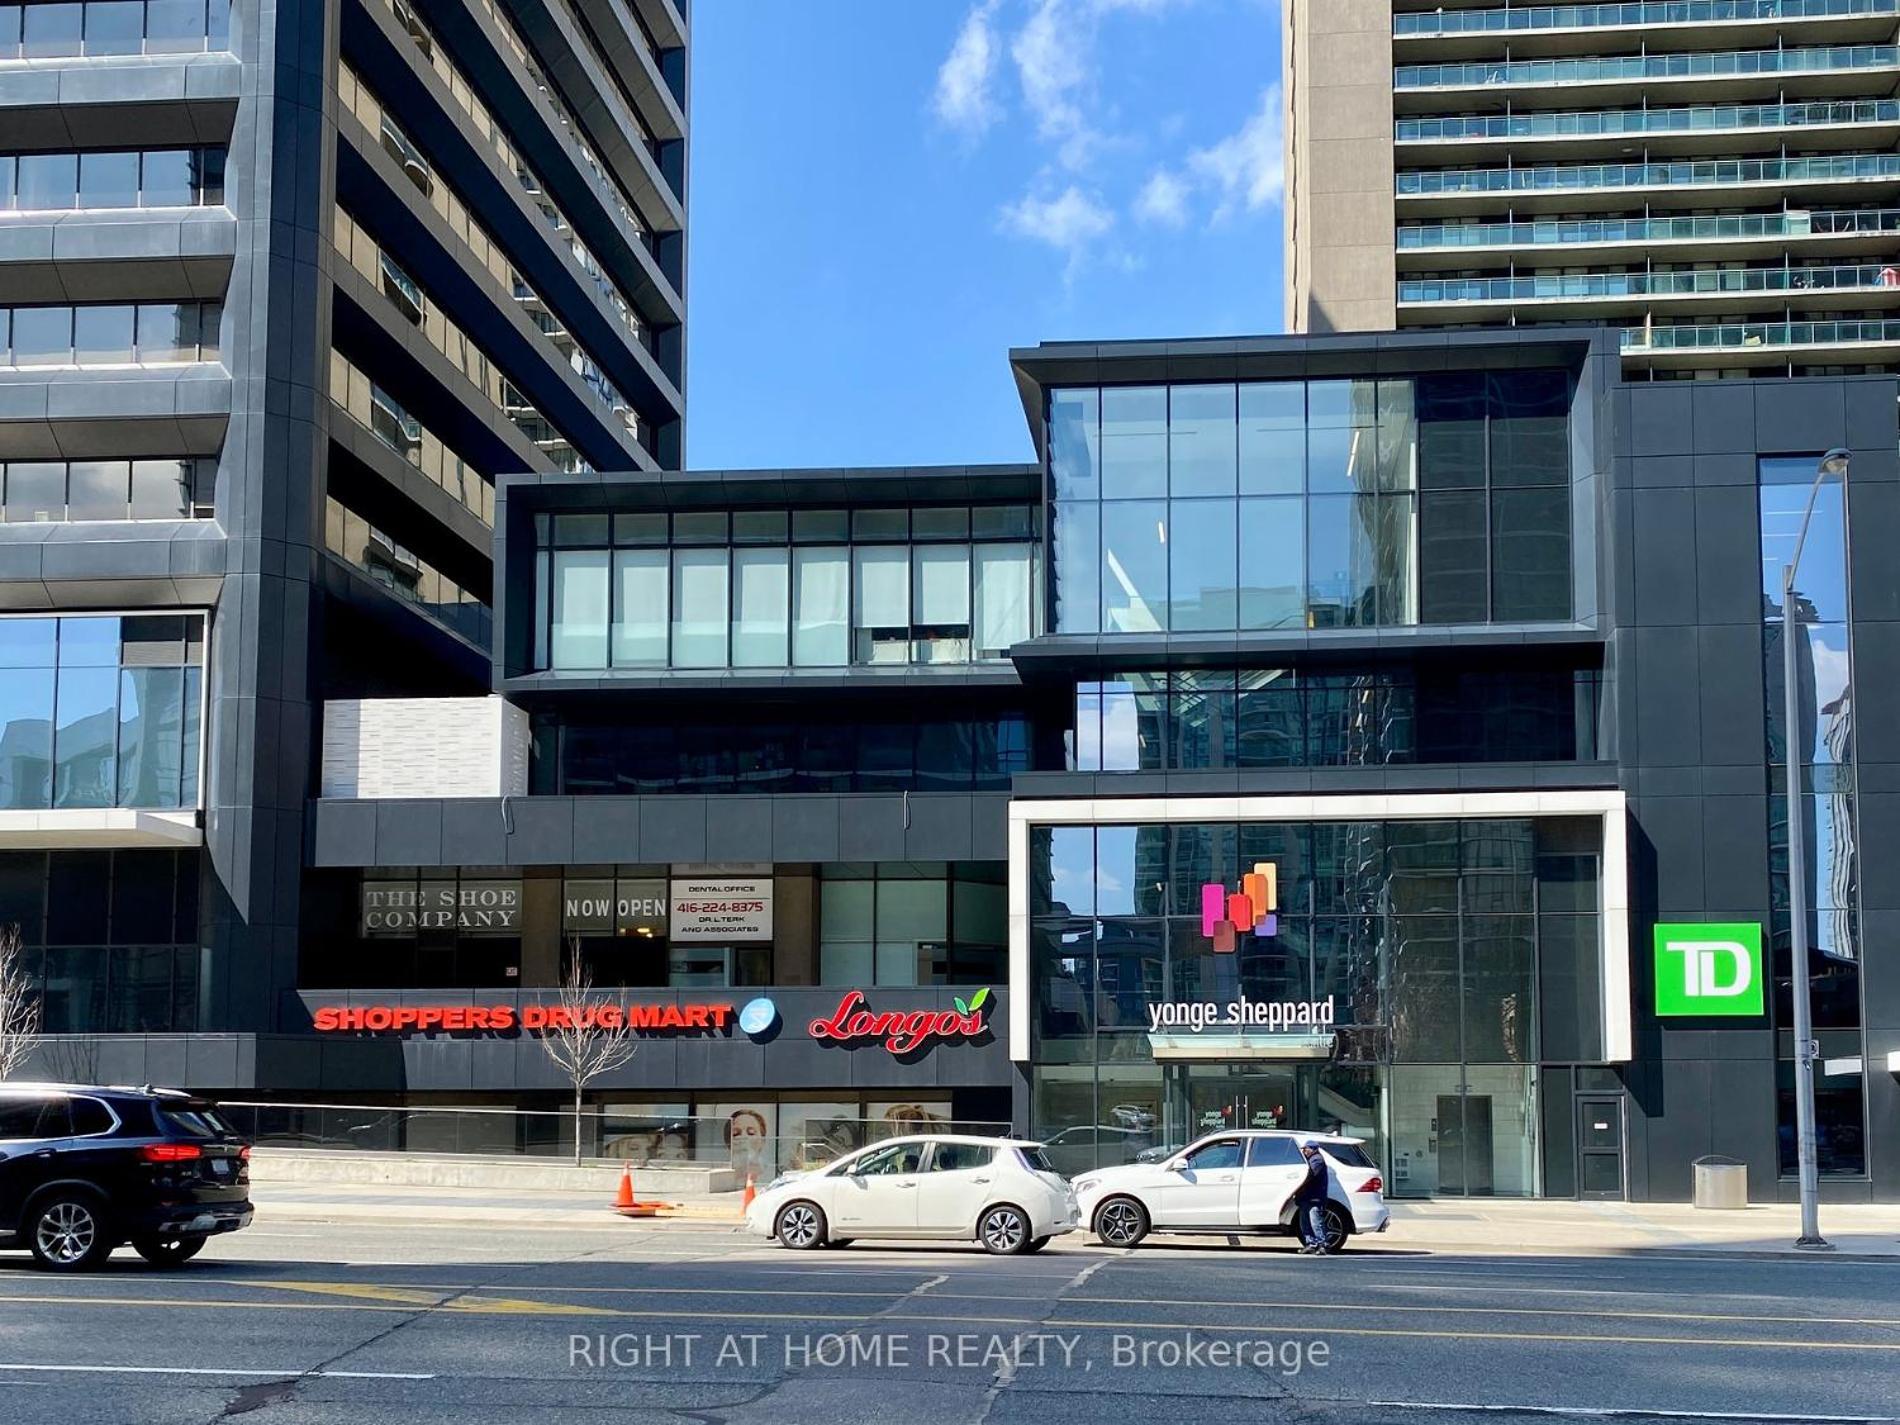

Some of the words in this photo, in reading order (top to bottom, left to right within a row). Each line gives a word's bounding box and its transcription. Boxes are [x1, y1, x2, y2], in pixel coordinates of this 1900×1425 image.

[366, 891, 426, 906] THE
[440, 889, 516, 906] SHOE
[567, 899, 609, 916] NOW
[617, 899, 666, 916] OPEN
[677, 902, 763, 912] 416-224-8375
[366, 910, 516, 928] COMPANY
[1666, 941, 1752, 997] TD
[313, 1006, 514, 1031] SHOPPERS
[523, 1005, 622, 1029] DRUG
[629, 1004, 732, 1028] MART
[1148, 1001, 1218, 1032] yonge
[1226, 995, 1335, 1032] sheppard
